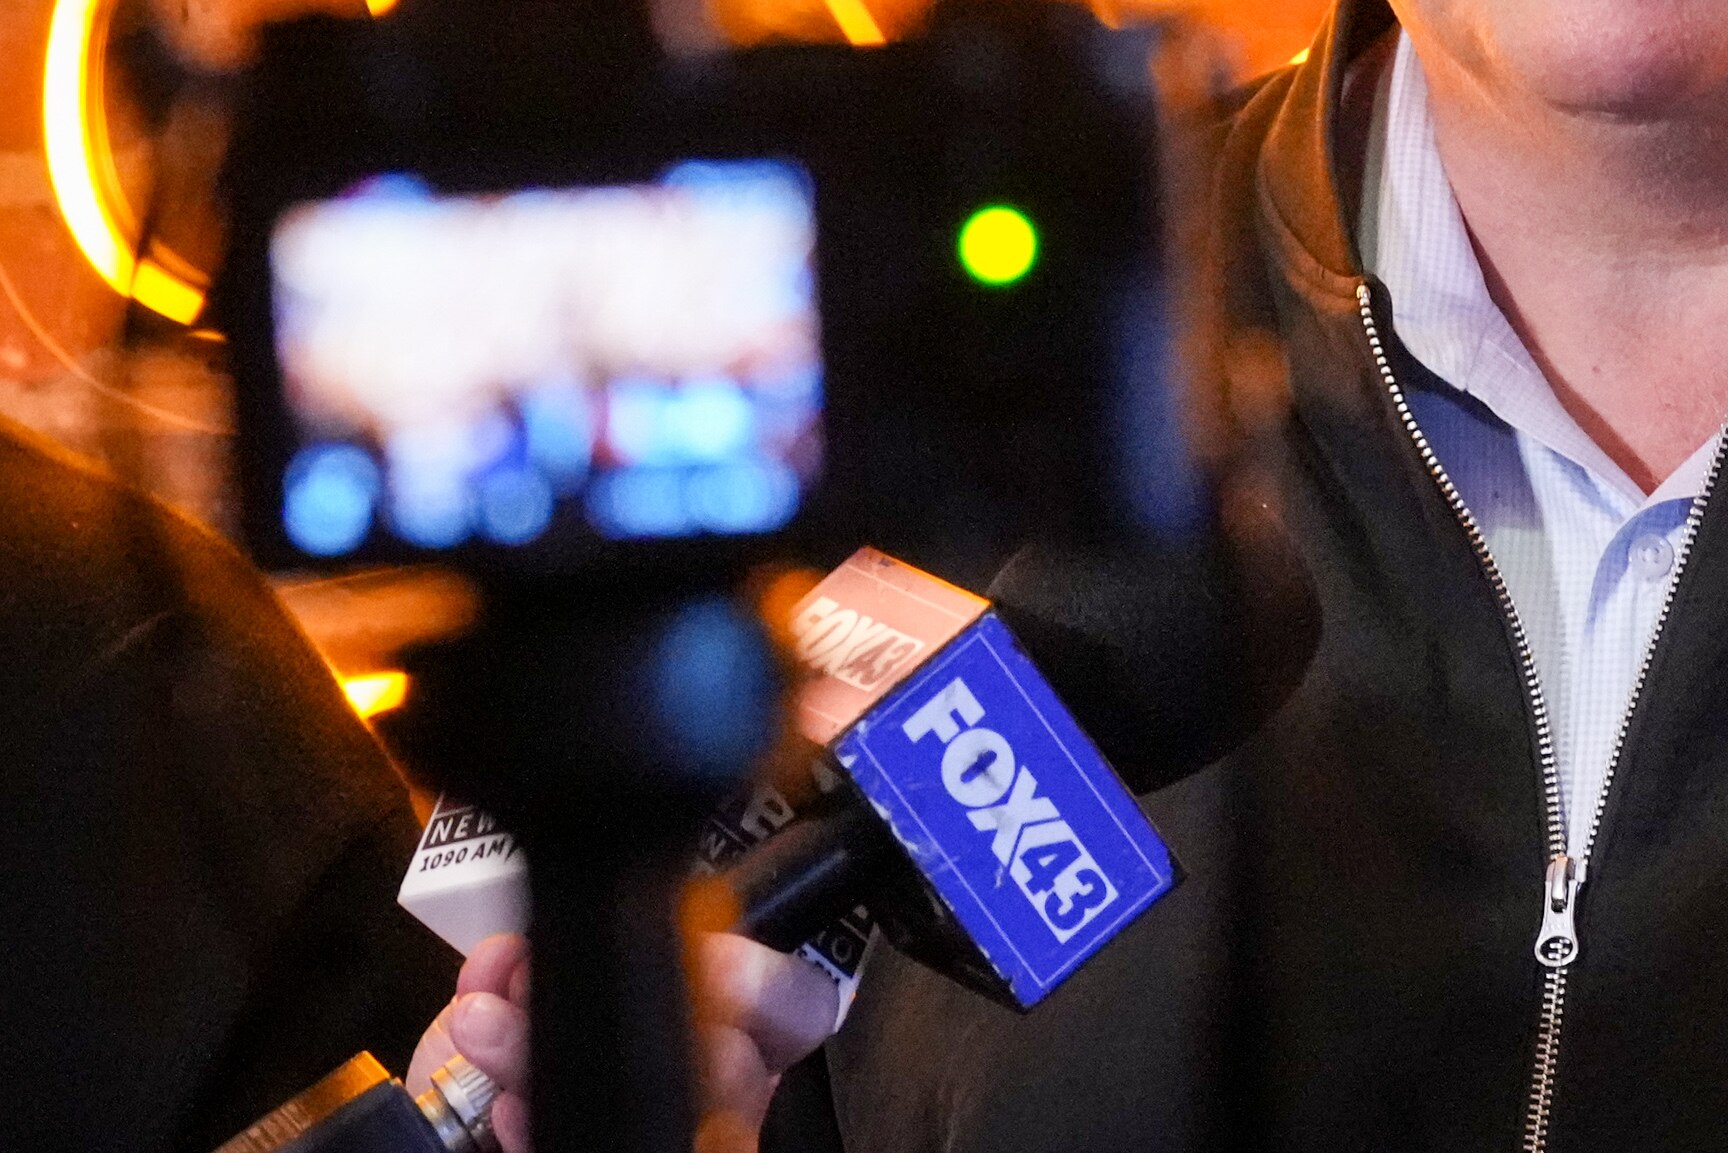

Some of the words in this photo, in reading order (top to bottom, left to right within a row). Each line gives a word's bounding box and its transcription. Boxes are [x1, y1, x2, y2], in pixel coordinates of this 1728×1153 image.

[796, 596, 926, 692] FOX43
[902, 677, 1119, 944] FOX43
[419, 847, 468, 872] 1090
